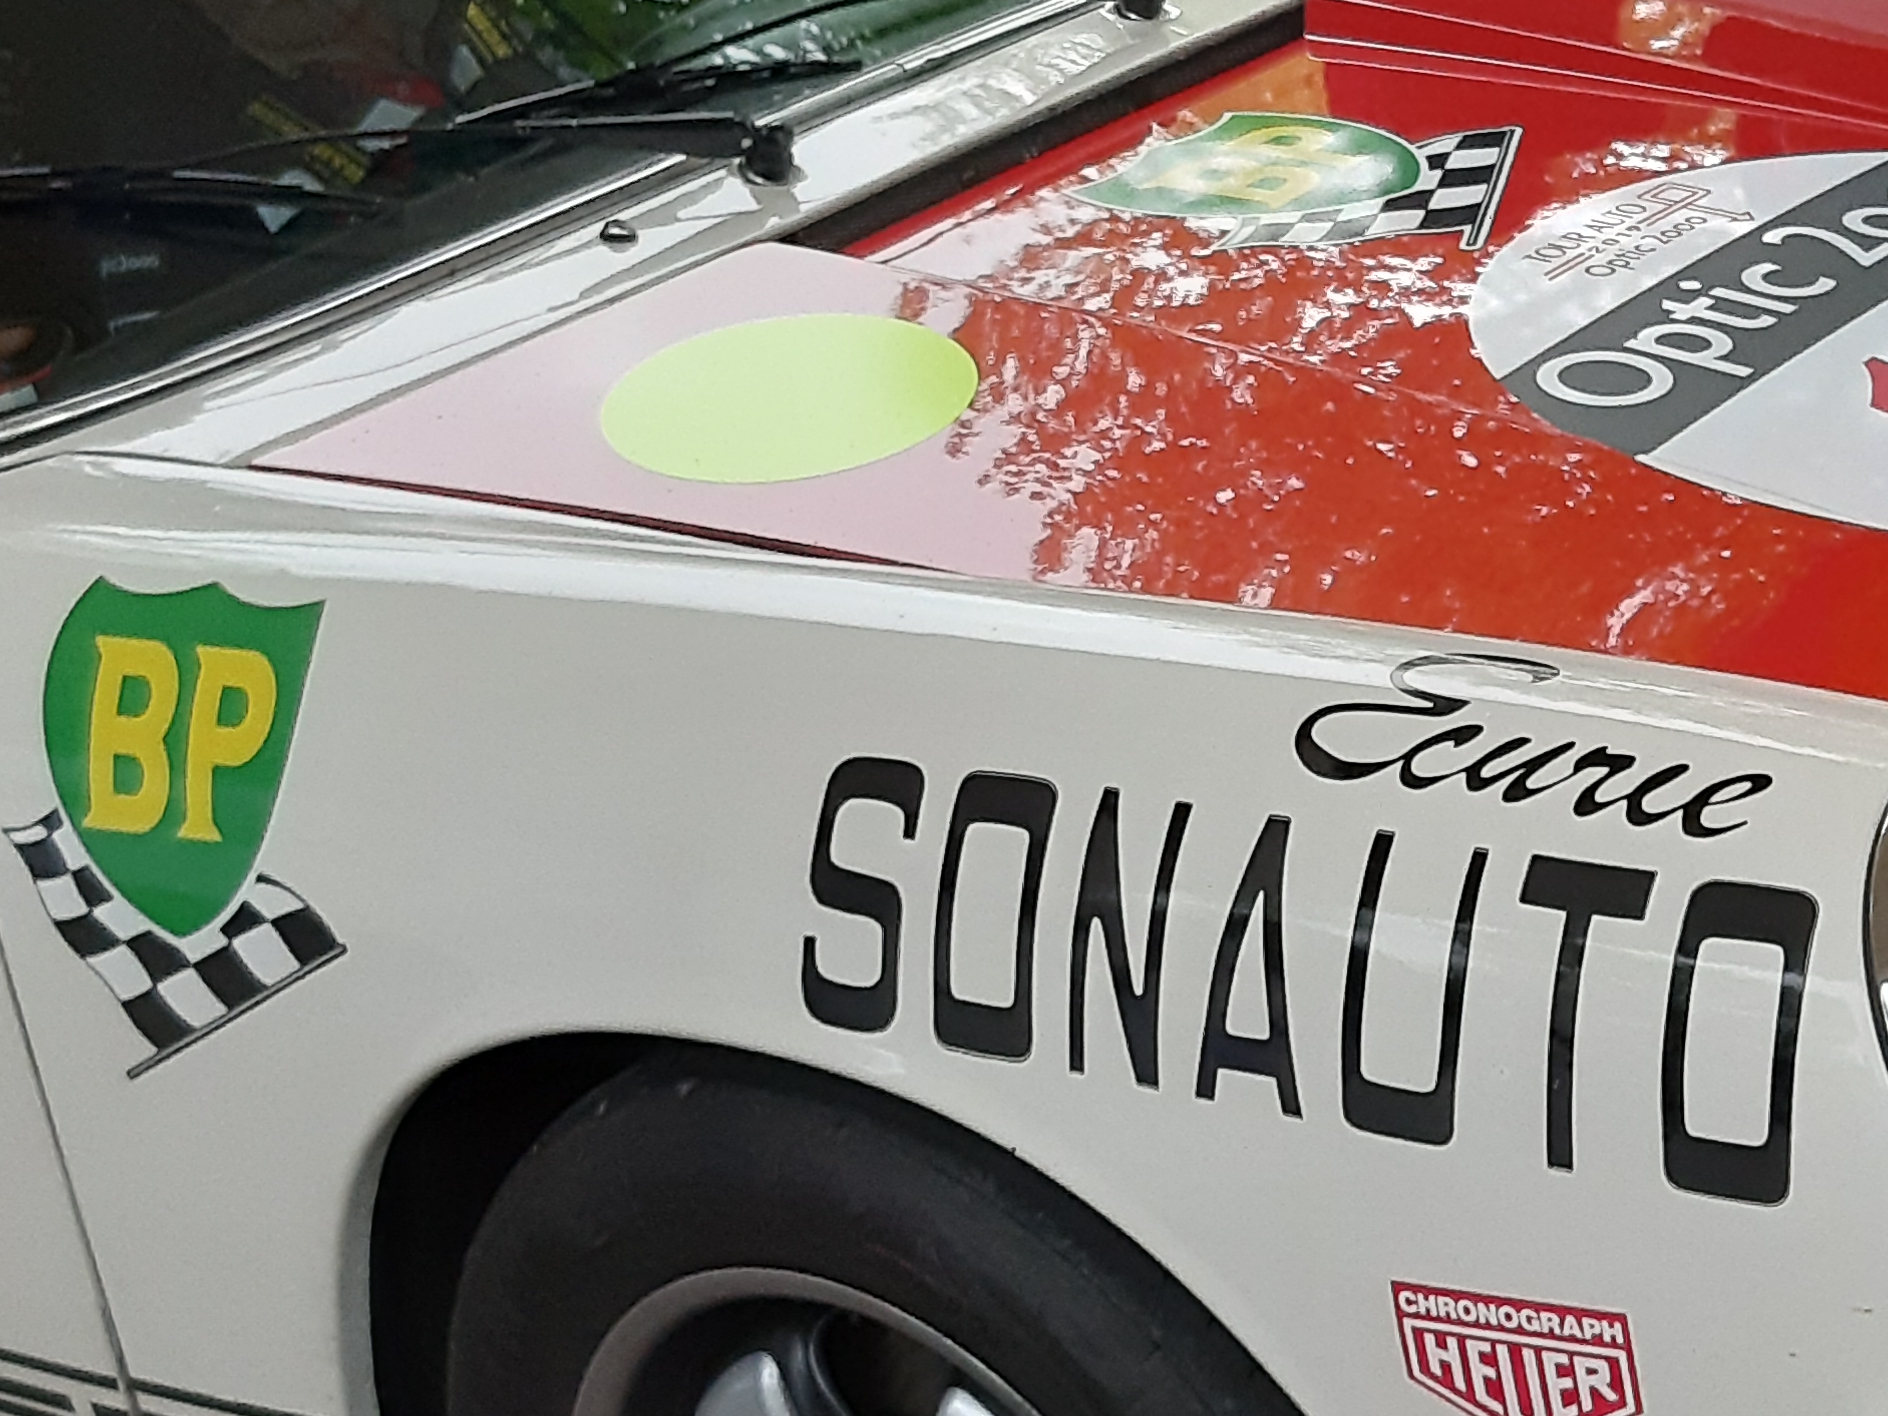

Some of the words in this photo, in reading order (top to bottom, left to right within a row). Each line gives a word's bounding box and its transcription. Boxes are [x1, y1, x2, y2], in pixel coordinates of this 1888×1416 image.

[1522, 231, 1597, 264] TOUR
[1583, 203, 1648, 234] AUTO
[1584, 243, 1658, 278] Optic
[1640, 216, 1708, 245] 2000
[1534, 277, 1837, 409] Optic
[82, 634, 278, 844] BP
[1293, 652, 1775, 840] Ecurie
[799, 755, 1820, 1208] SONAUTO
[1398, 1289, 1625, 1345] CHRONOGRAPH
